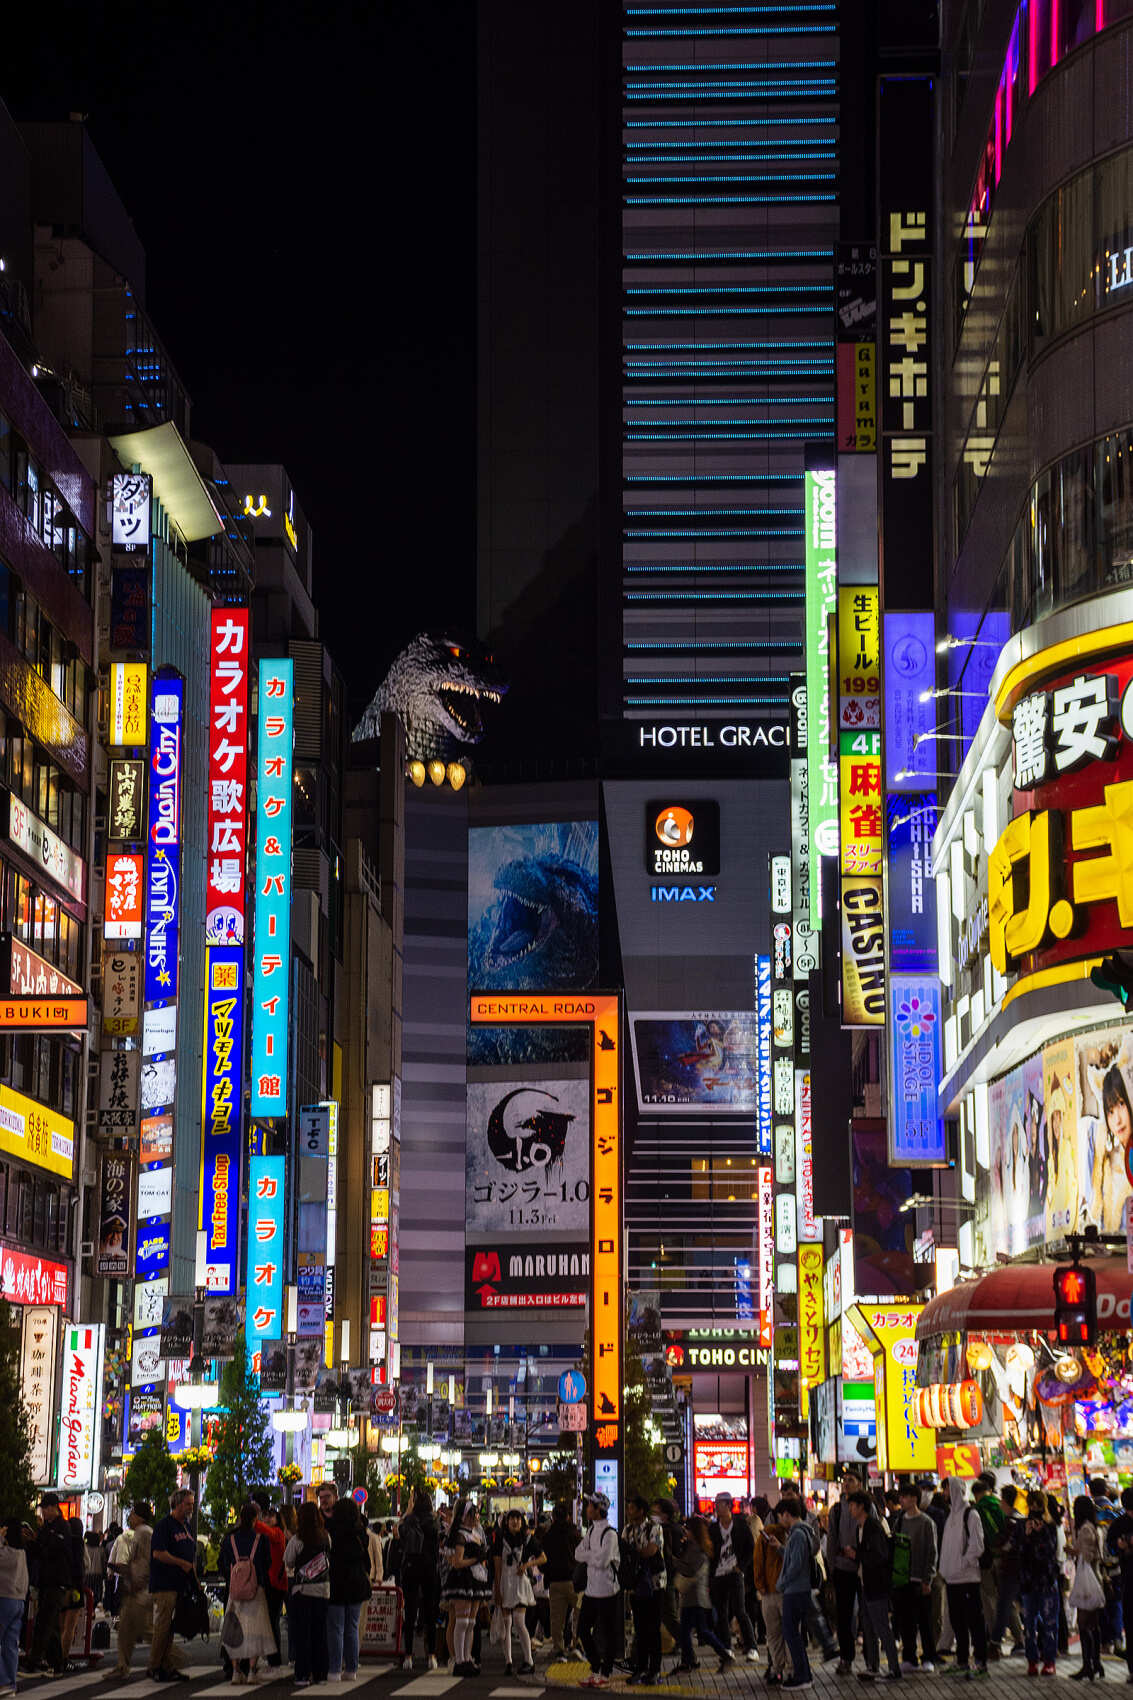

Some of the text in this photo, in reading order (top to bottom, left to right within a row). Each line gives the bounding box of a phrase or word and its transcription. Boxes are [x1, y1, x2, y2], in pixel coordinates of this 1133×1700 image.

[119, 480, 143, 537] ダーツ
[853, 594, 873, 670] 生ビール
[640, 726, 791, 747] HOTEL GRAC
[852, 733, 880, 754] 4F
[1012, 674, 1133, 791] 驚安
[210, 619, 244, 894] カラオケ歌広場
[849, 763, 881, 838] 麻雀
[12, 804, 24, 838] 3F
[654, 849, 690, 862] TOHO
[654, 861, 704, 873] CINEMAS
[651, 886, 715, 902] IMAX
[149, 863, 170, 968] SHINJUKU
[843, 887, 886, 1015] CASINO
[477, 1003, 596, 1015] CENTRAL ROAD
[111, 1019, 131, 1032] 3F
[211, 998, 238, 1136] マツモトキヨシ
[903, 1042, 919, 1102] STAGE
[918, 1042, 932, 1091] IDOL
[101, 1111, 135, 1126] 大阪家
[905, 1120, 931, 1138] 5F
[106, 1160, 125, 1213] 海の家
[474, 1180, 590, 1204] ゴジラ-1.0
[211, 1153, 232, 1250] Tax Free Shop
[510, 1207, 540, 1225] 11.3
[597, 1086, 616, 1358] ゴジラロード
[509, 1252, 590, 1277] MARUHAN
[872, 1311, 921, 1328] カラオ
[688, 1348, 735, 1366] TOHO
